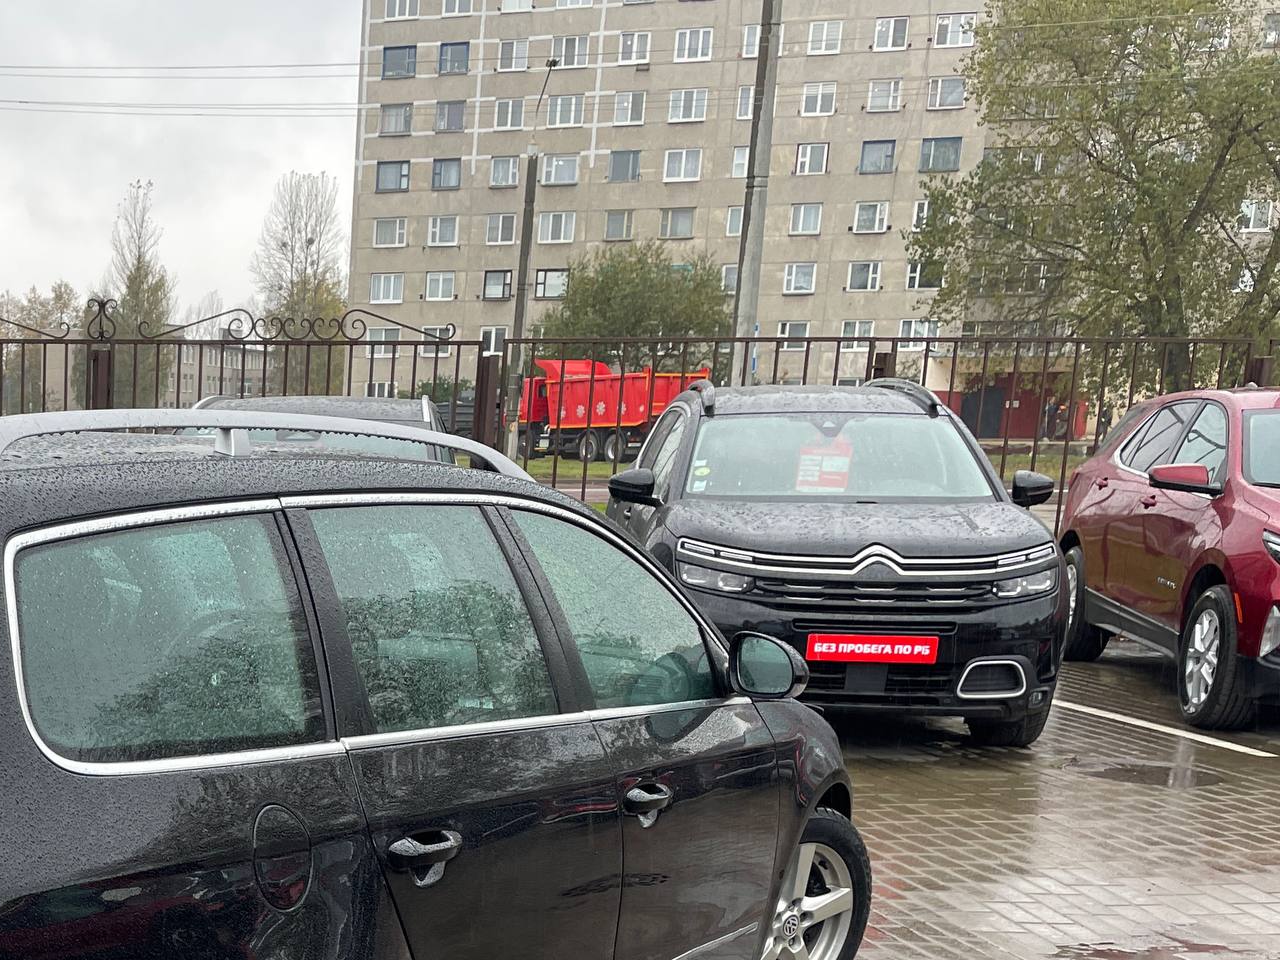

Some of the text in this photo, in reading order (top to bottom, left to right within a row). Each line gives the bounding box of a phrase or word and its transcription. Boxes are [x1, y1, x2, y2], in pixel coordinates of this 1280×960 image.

[814, 642, 931, 656] БЕЗ ПРОБЕГА ПО РБ
